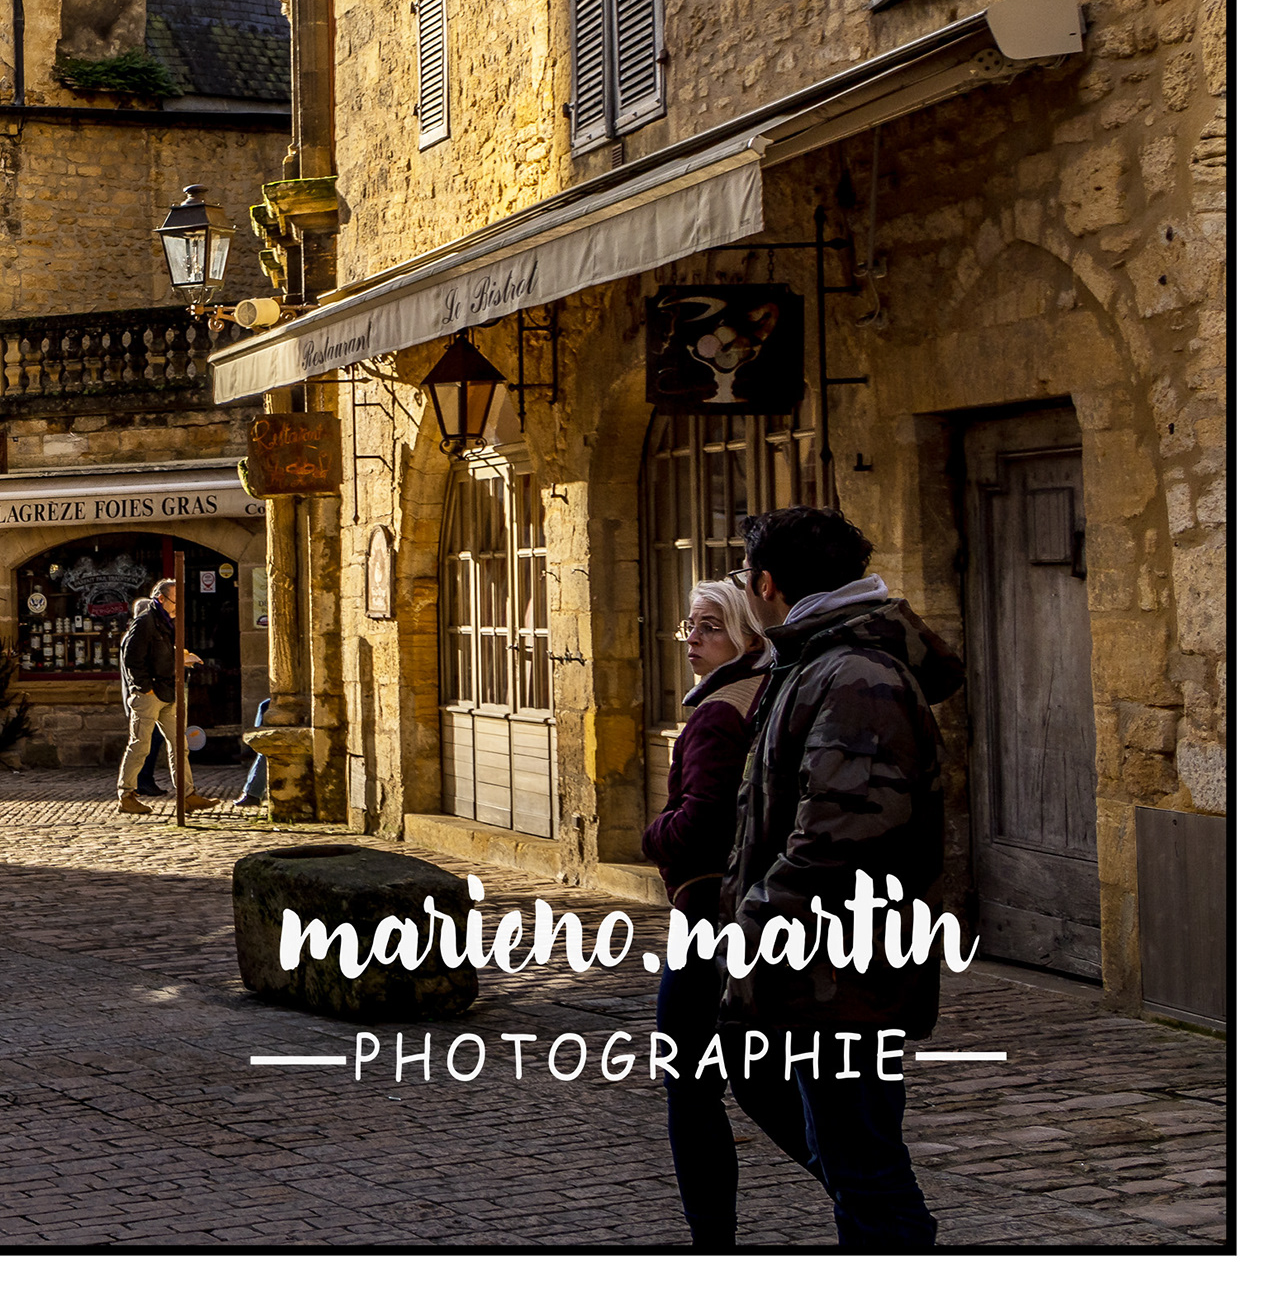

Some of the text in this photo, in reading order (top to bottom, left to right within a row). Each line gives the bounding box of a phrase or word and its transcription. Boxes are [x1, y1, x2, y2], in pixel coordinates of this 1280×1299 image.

[301, 260, 538, 371] Restaurant Le Bistrot
[94, 498, 154, 520] FOIES
[161, 495, 218, 516] GRAS
